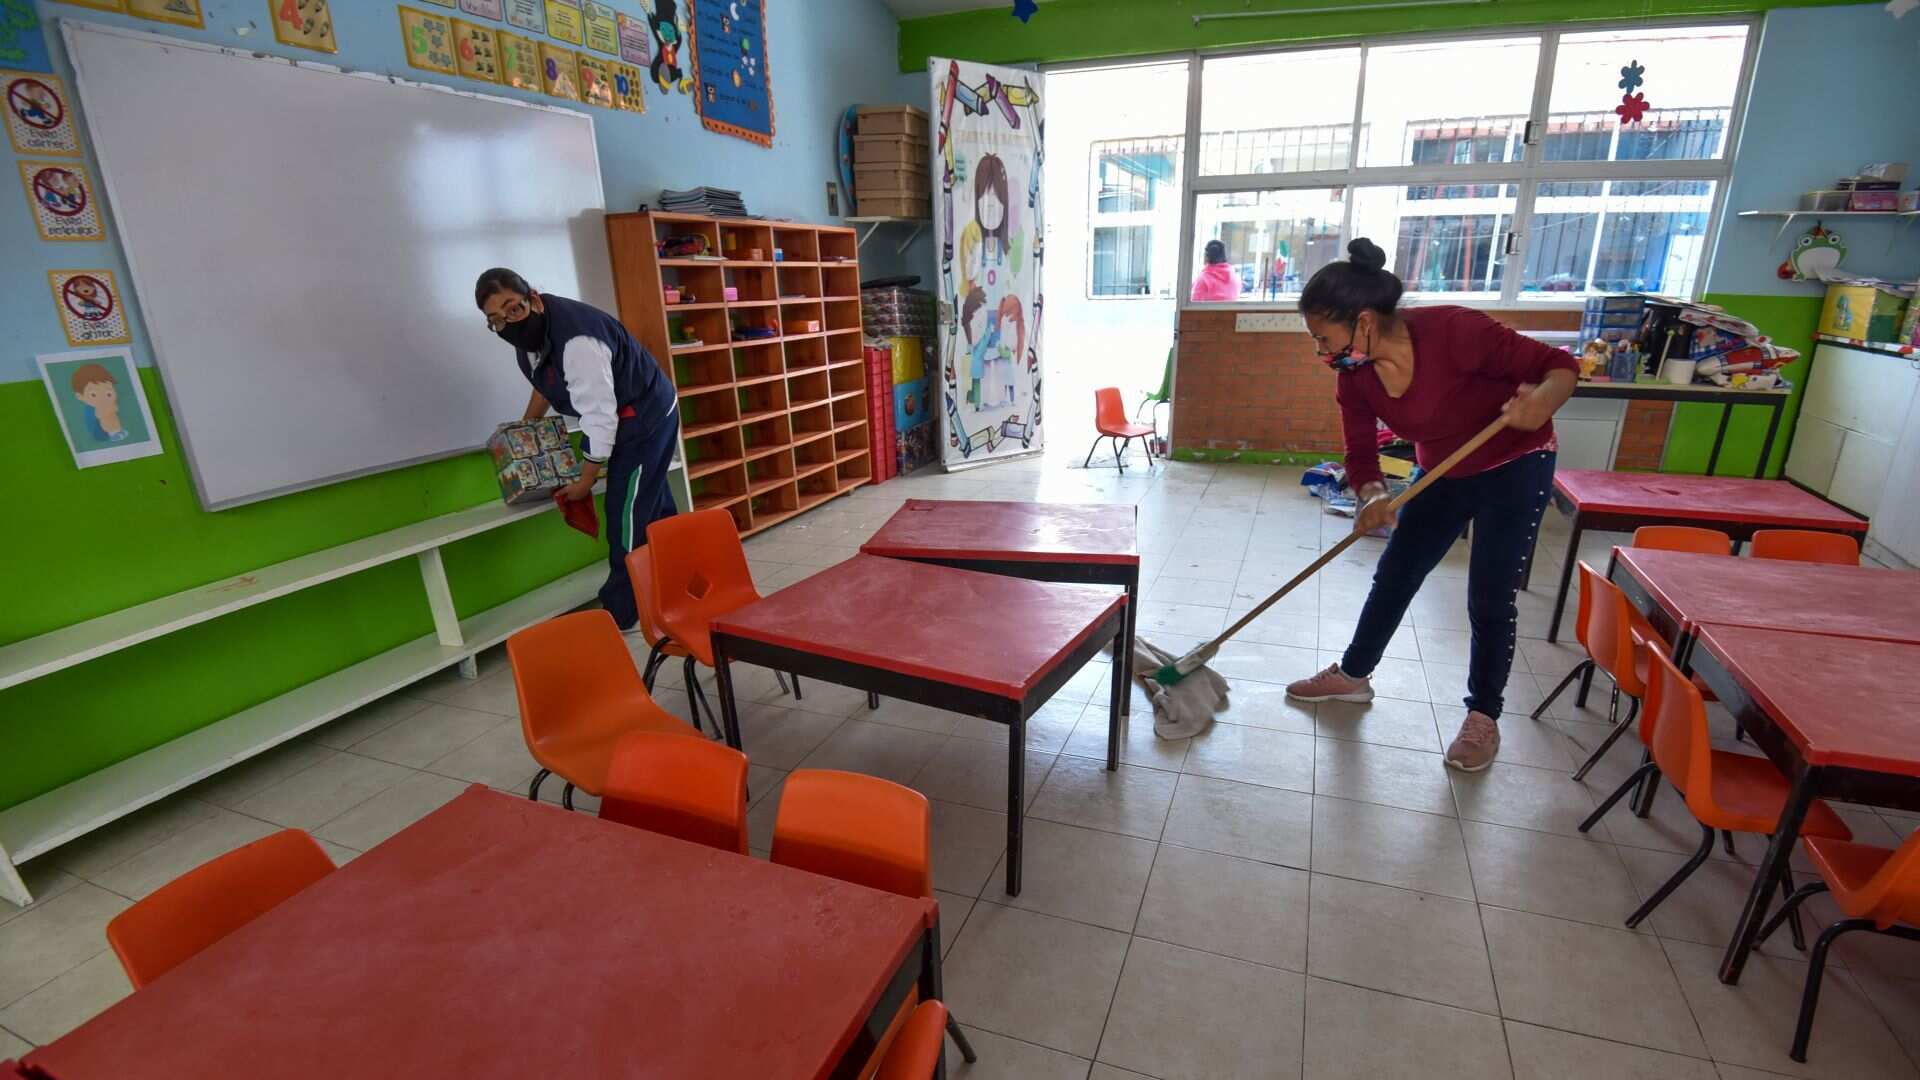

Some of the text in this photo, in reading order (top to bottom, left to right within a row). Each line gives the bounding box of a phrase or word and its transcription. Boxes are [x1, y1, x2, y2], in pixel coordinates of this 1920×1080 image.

[412, 25, 428, 54] 5
[461, 37, 475, 61] 6
[506, 47, 518, 69] 7
[545, 58, 558, 81] 8
[582, 68, 595, 89] 9
[614, 74, 629, 96] 10
